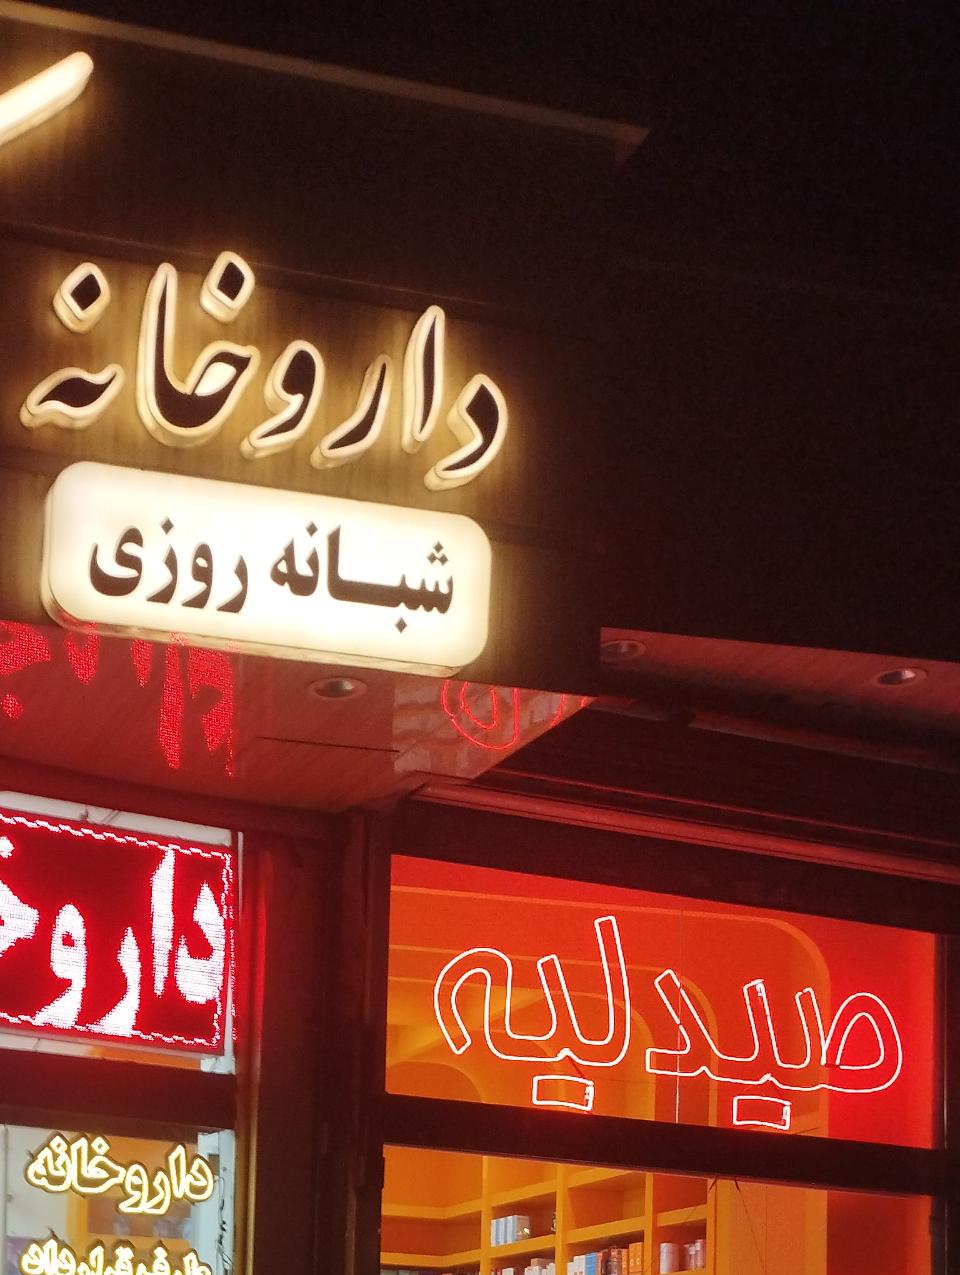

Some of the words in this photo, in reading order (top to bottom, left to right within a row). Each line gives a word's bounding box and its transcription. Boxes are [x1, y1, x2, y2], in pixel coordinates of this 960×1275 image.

[20, 250, 509, 490] داروخانه
[88, 516, 250, 615] روزی
[269, 520, 455, 634] شبانه
[26, 1133, 215, 1216] داروخانه
